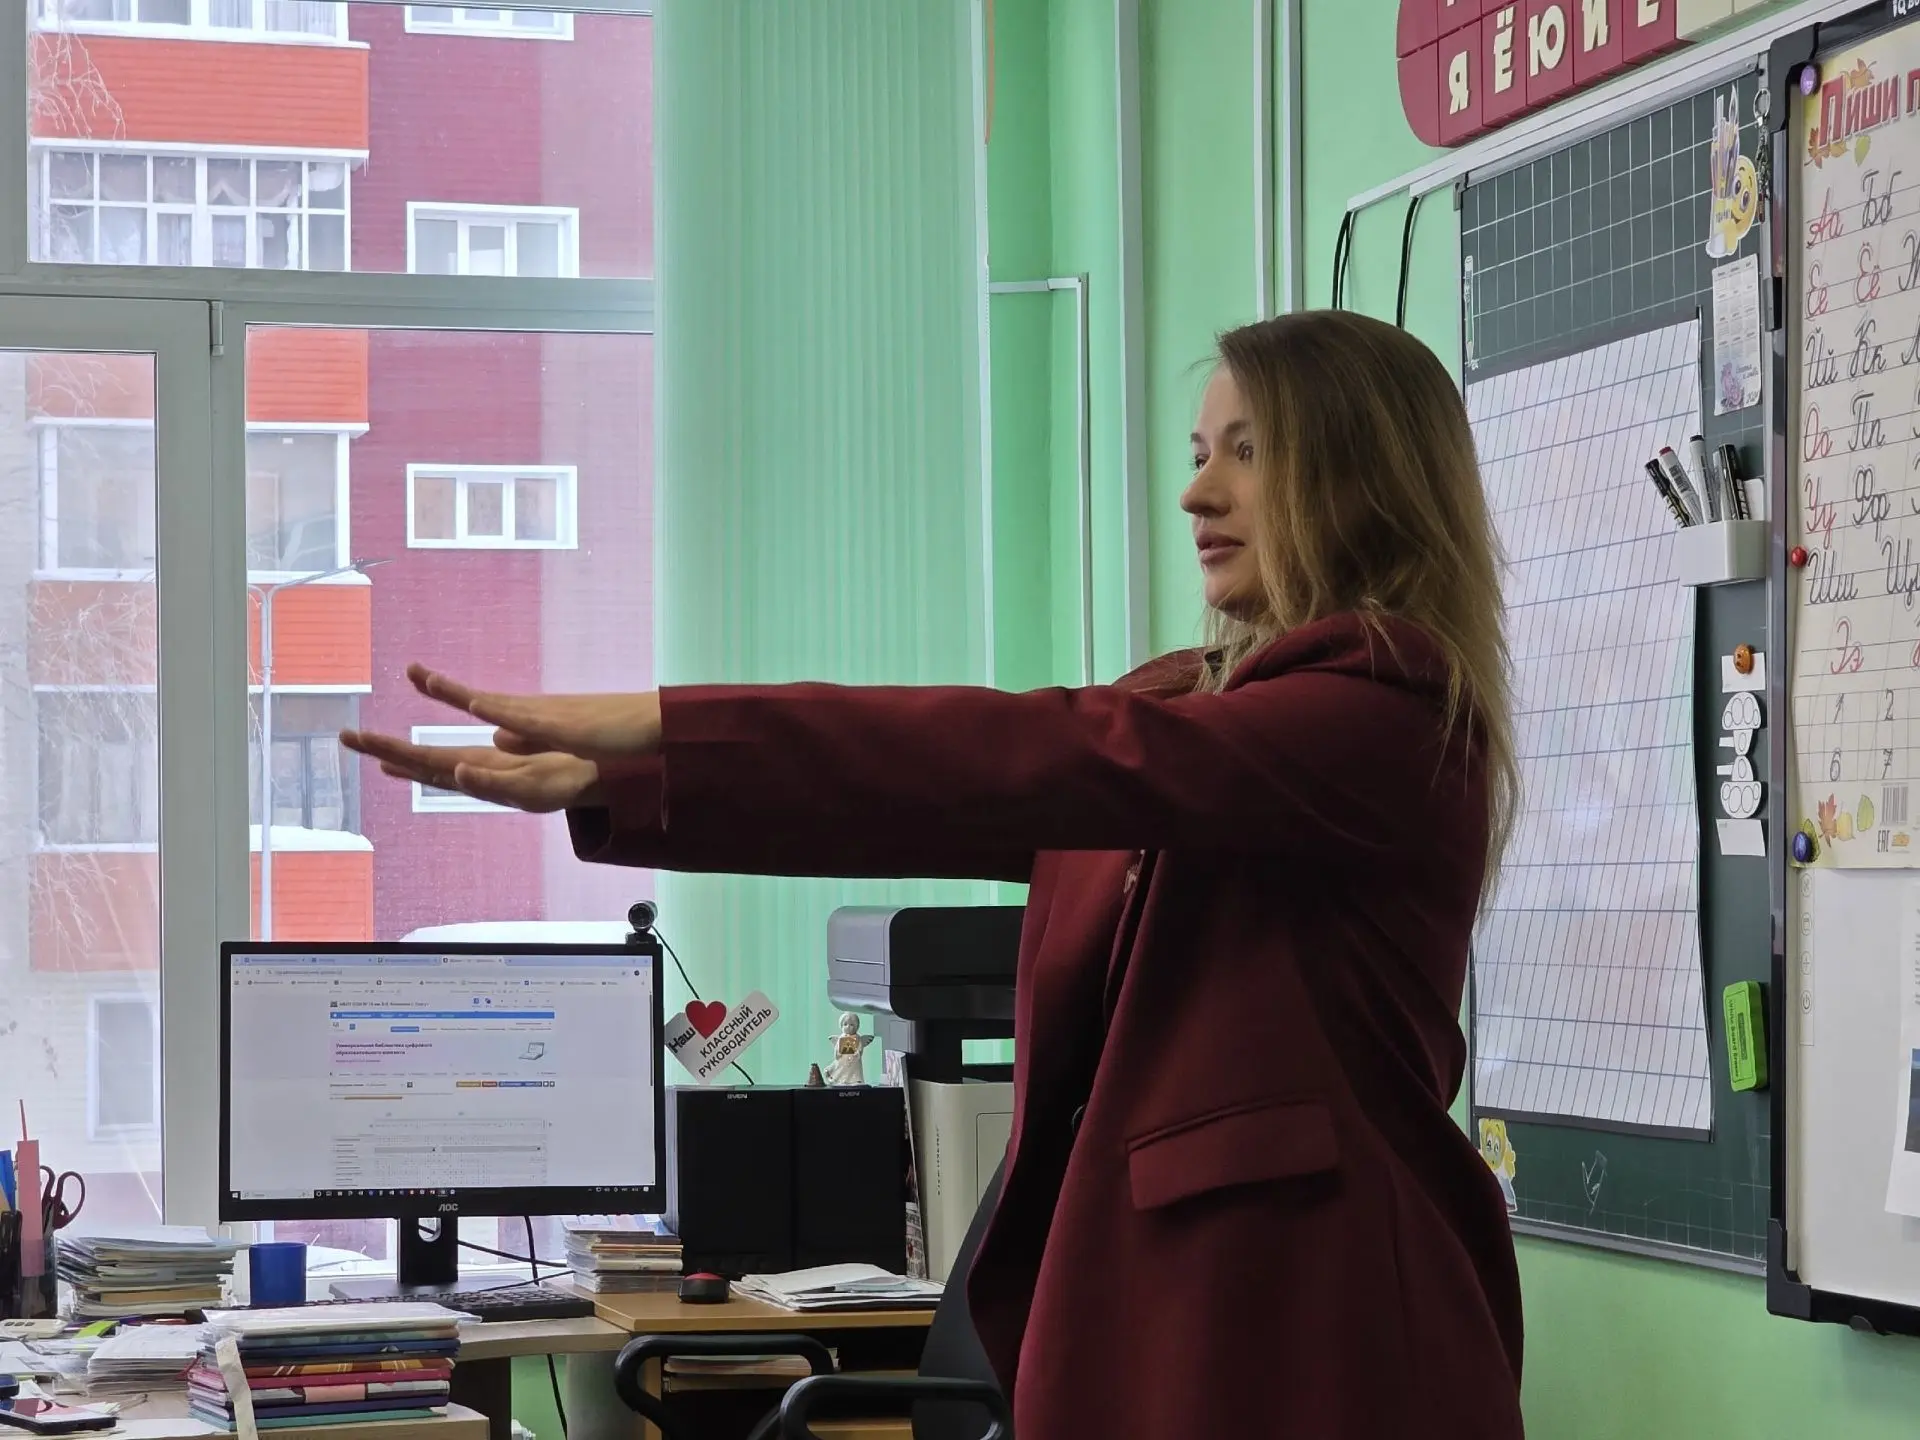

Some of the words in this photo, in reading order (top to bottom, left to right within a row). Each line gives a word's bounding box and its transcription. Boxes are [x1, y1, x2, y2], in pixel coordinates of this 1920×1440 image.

[1818, 74, 1899, 149] Пиши
[1833, 692, 1844, 724] 1
[1884, 688, 1894, 721] 2
[1830, 749, 1841, 782] 6
[1882, 749, 1894, 780] 7
[669, 1026, 696, 1054] Наш
[698, 1007, 772, 1078] РУКОВОДИТЕЛЬ
[700, 1004, 753, 1059] КЛАССНЫЙ
